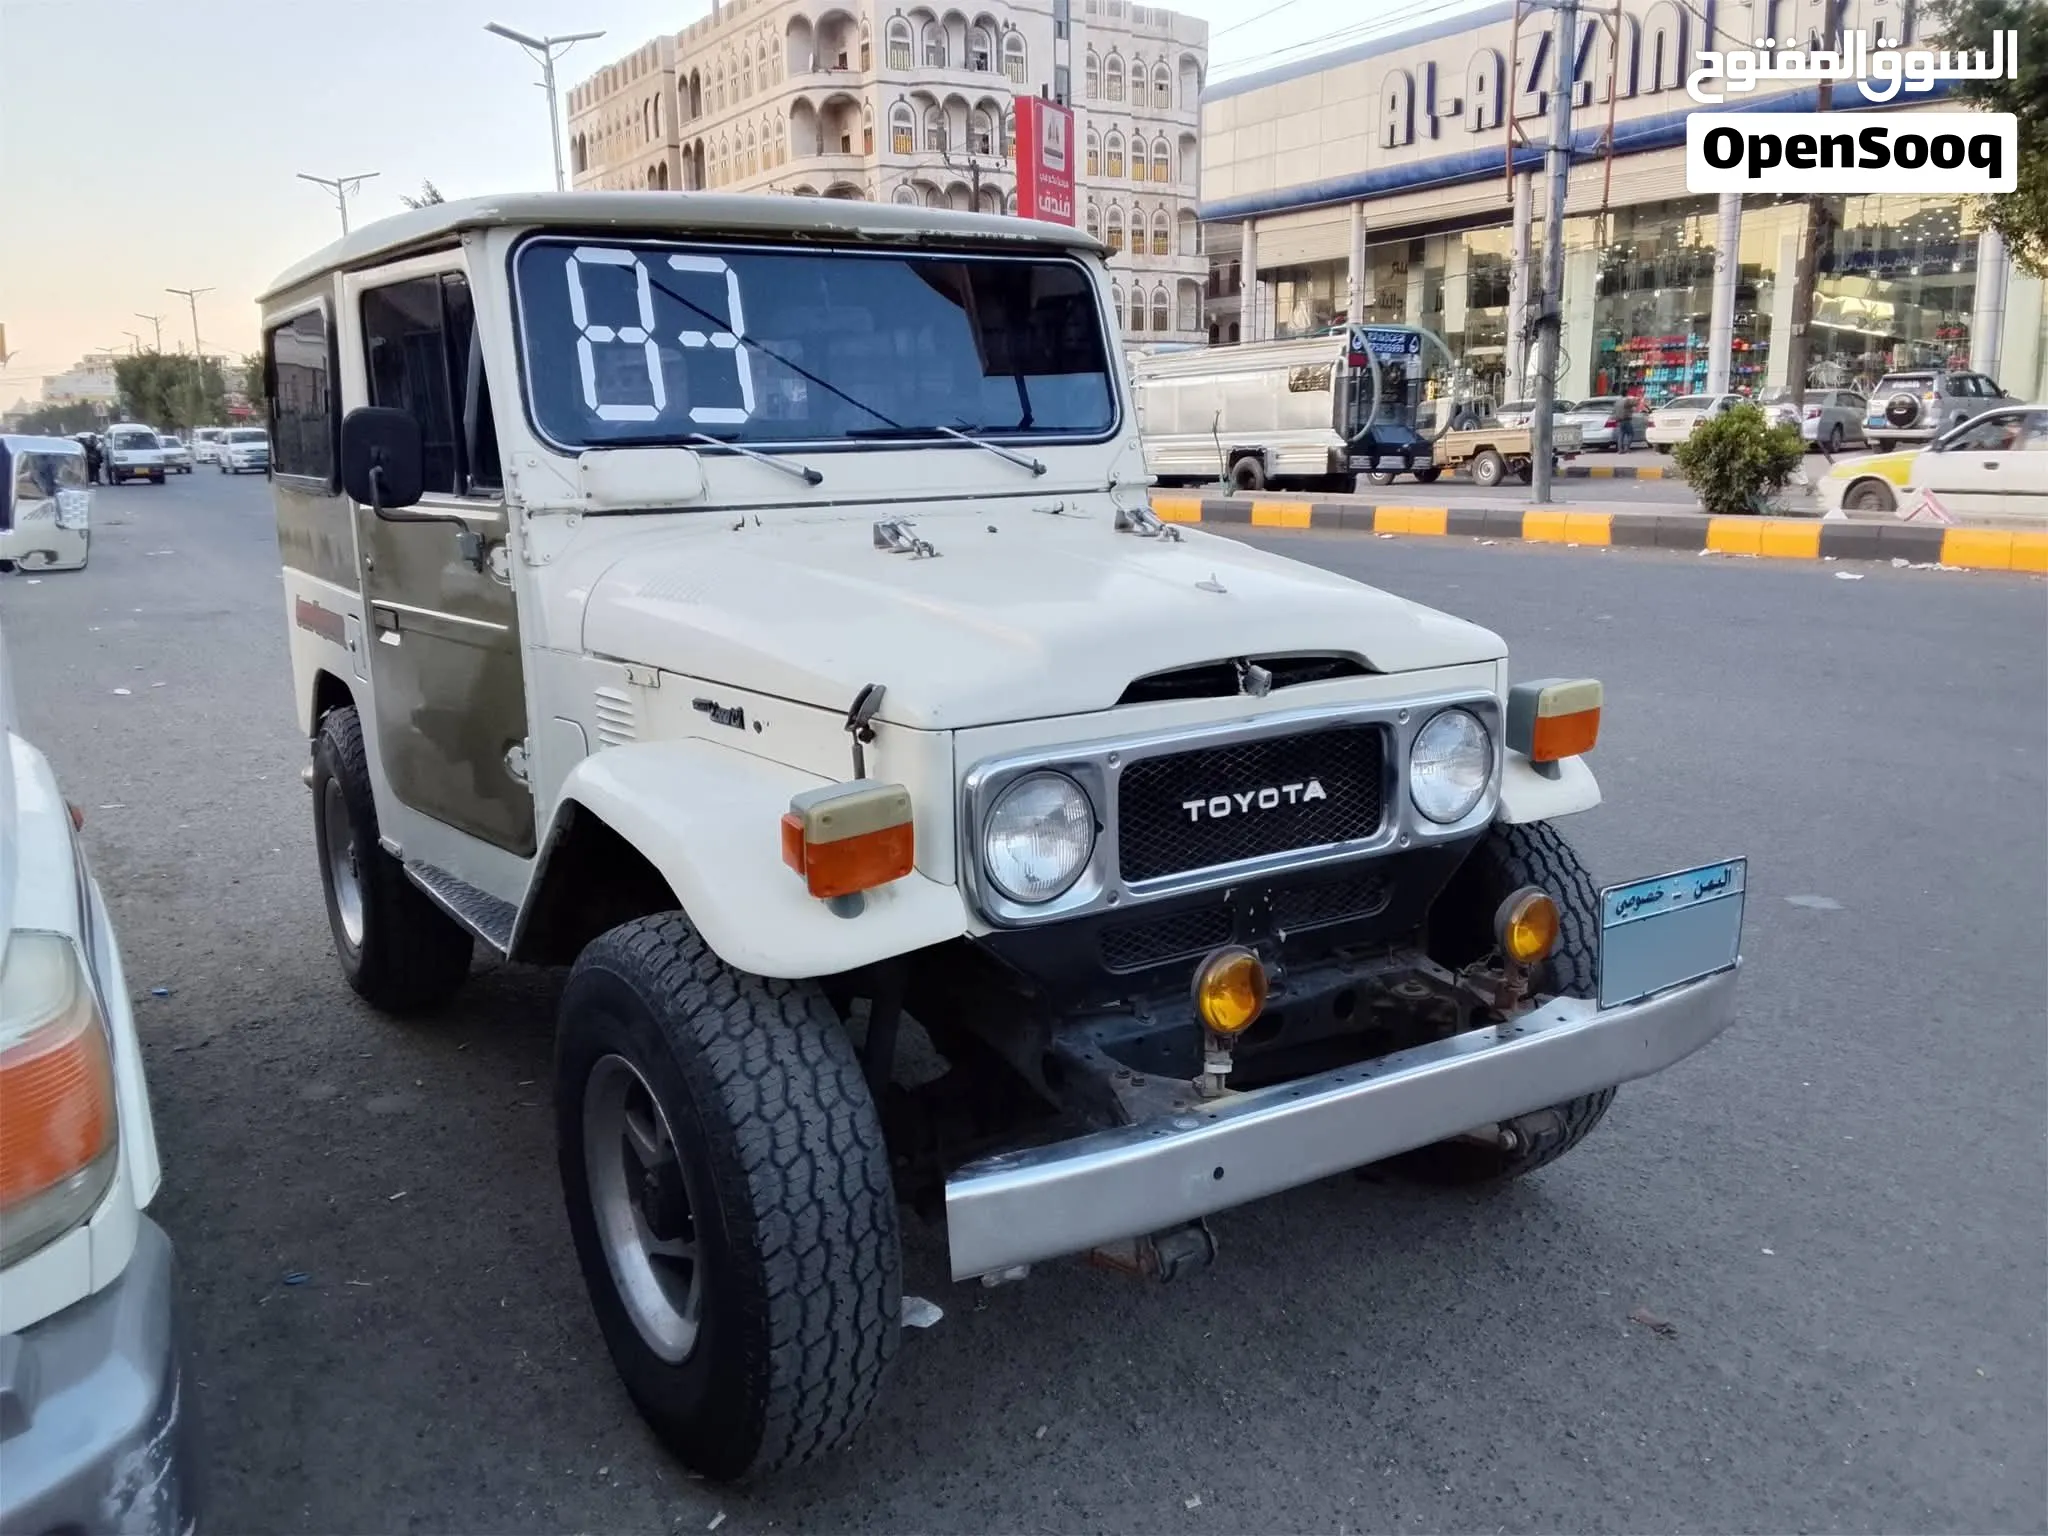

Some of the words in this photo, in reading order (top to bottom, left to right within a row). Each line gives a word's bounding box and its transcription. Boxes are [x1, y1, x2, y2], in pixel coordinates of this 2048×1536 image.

[1038, 190, 1071, 218] فندق
[565, 246, 755, 424] 83
[1182, 779, 1327, 822] TOYOTA
[1693, 866, 1732, 899] اليمن
[1615, 884, 1665, 918] خصوصي
